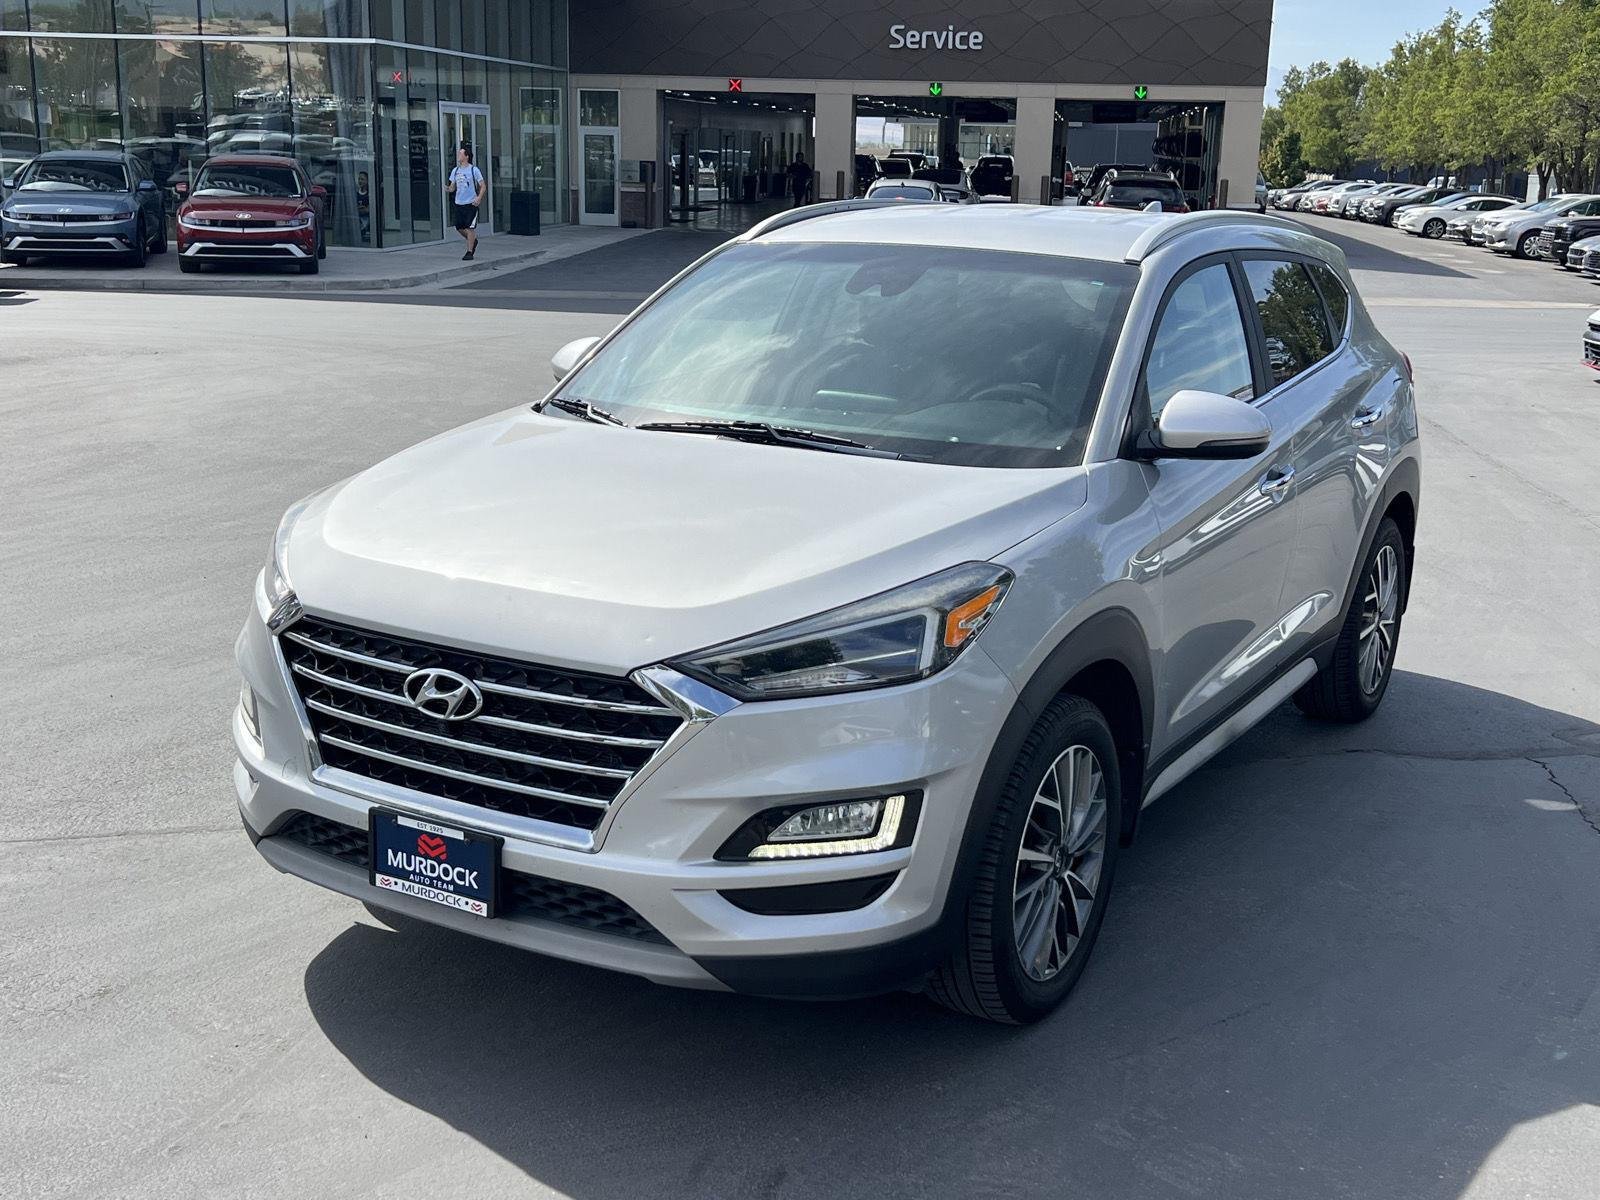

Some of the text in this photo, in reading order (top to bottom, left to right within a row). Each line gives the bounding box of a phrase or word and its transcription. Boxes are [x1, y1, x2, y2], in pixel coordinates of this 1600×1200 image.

[889, 24, 984, 50] Service
[429, 825, 444, 834] 1925
[387, 848, 479, 890] MURDOCK
[401, 881, 462, 908] MURDOCK
[409, 873, 454, 892] AUTO TEAM
